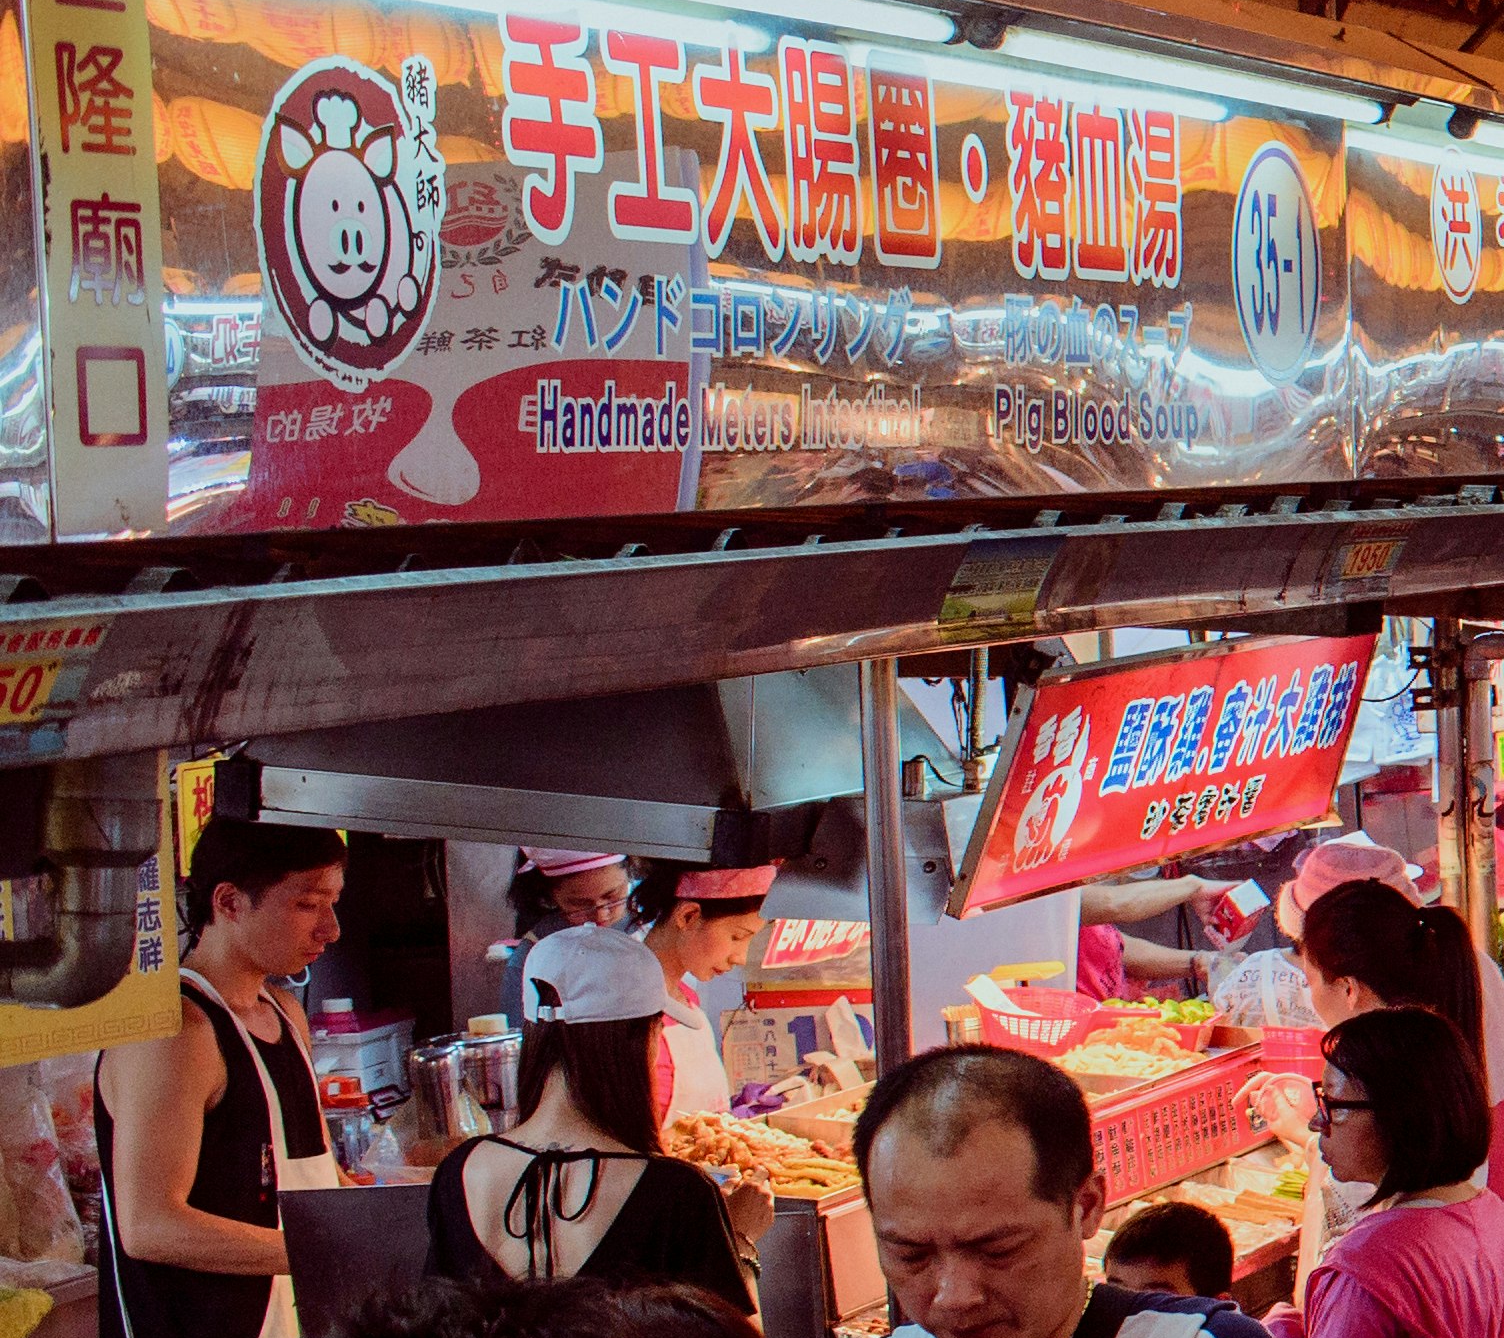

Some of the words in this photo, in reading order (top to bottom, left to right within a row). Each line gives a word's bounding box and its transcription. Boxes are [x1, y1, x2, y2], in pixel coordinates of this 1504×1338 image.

[1249, 189, 1309, 339] 35-1
[1441, 189, 1473, 267] 洪
[536, 379, 694, 455] Handmade
[700, 381, 794, 451] Meters
[994, 384, 1045, 454] Pig
[1052, 385, 1133, 447] Blood
[1138, 391, 1202, 452] Soup
[1346, 540, 1390, 575] 1950
